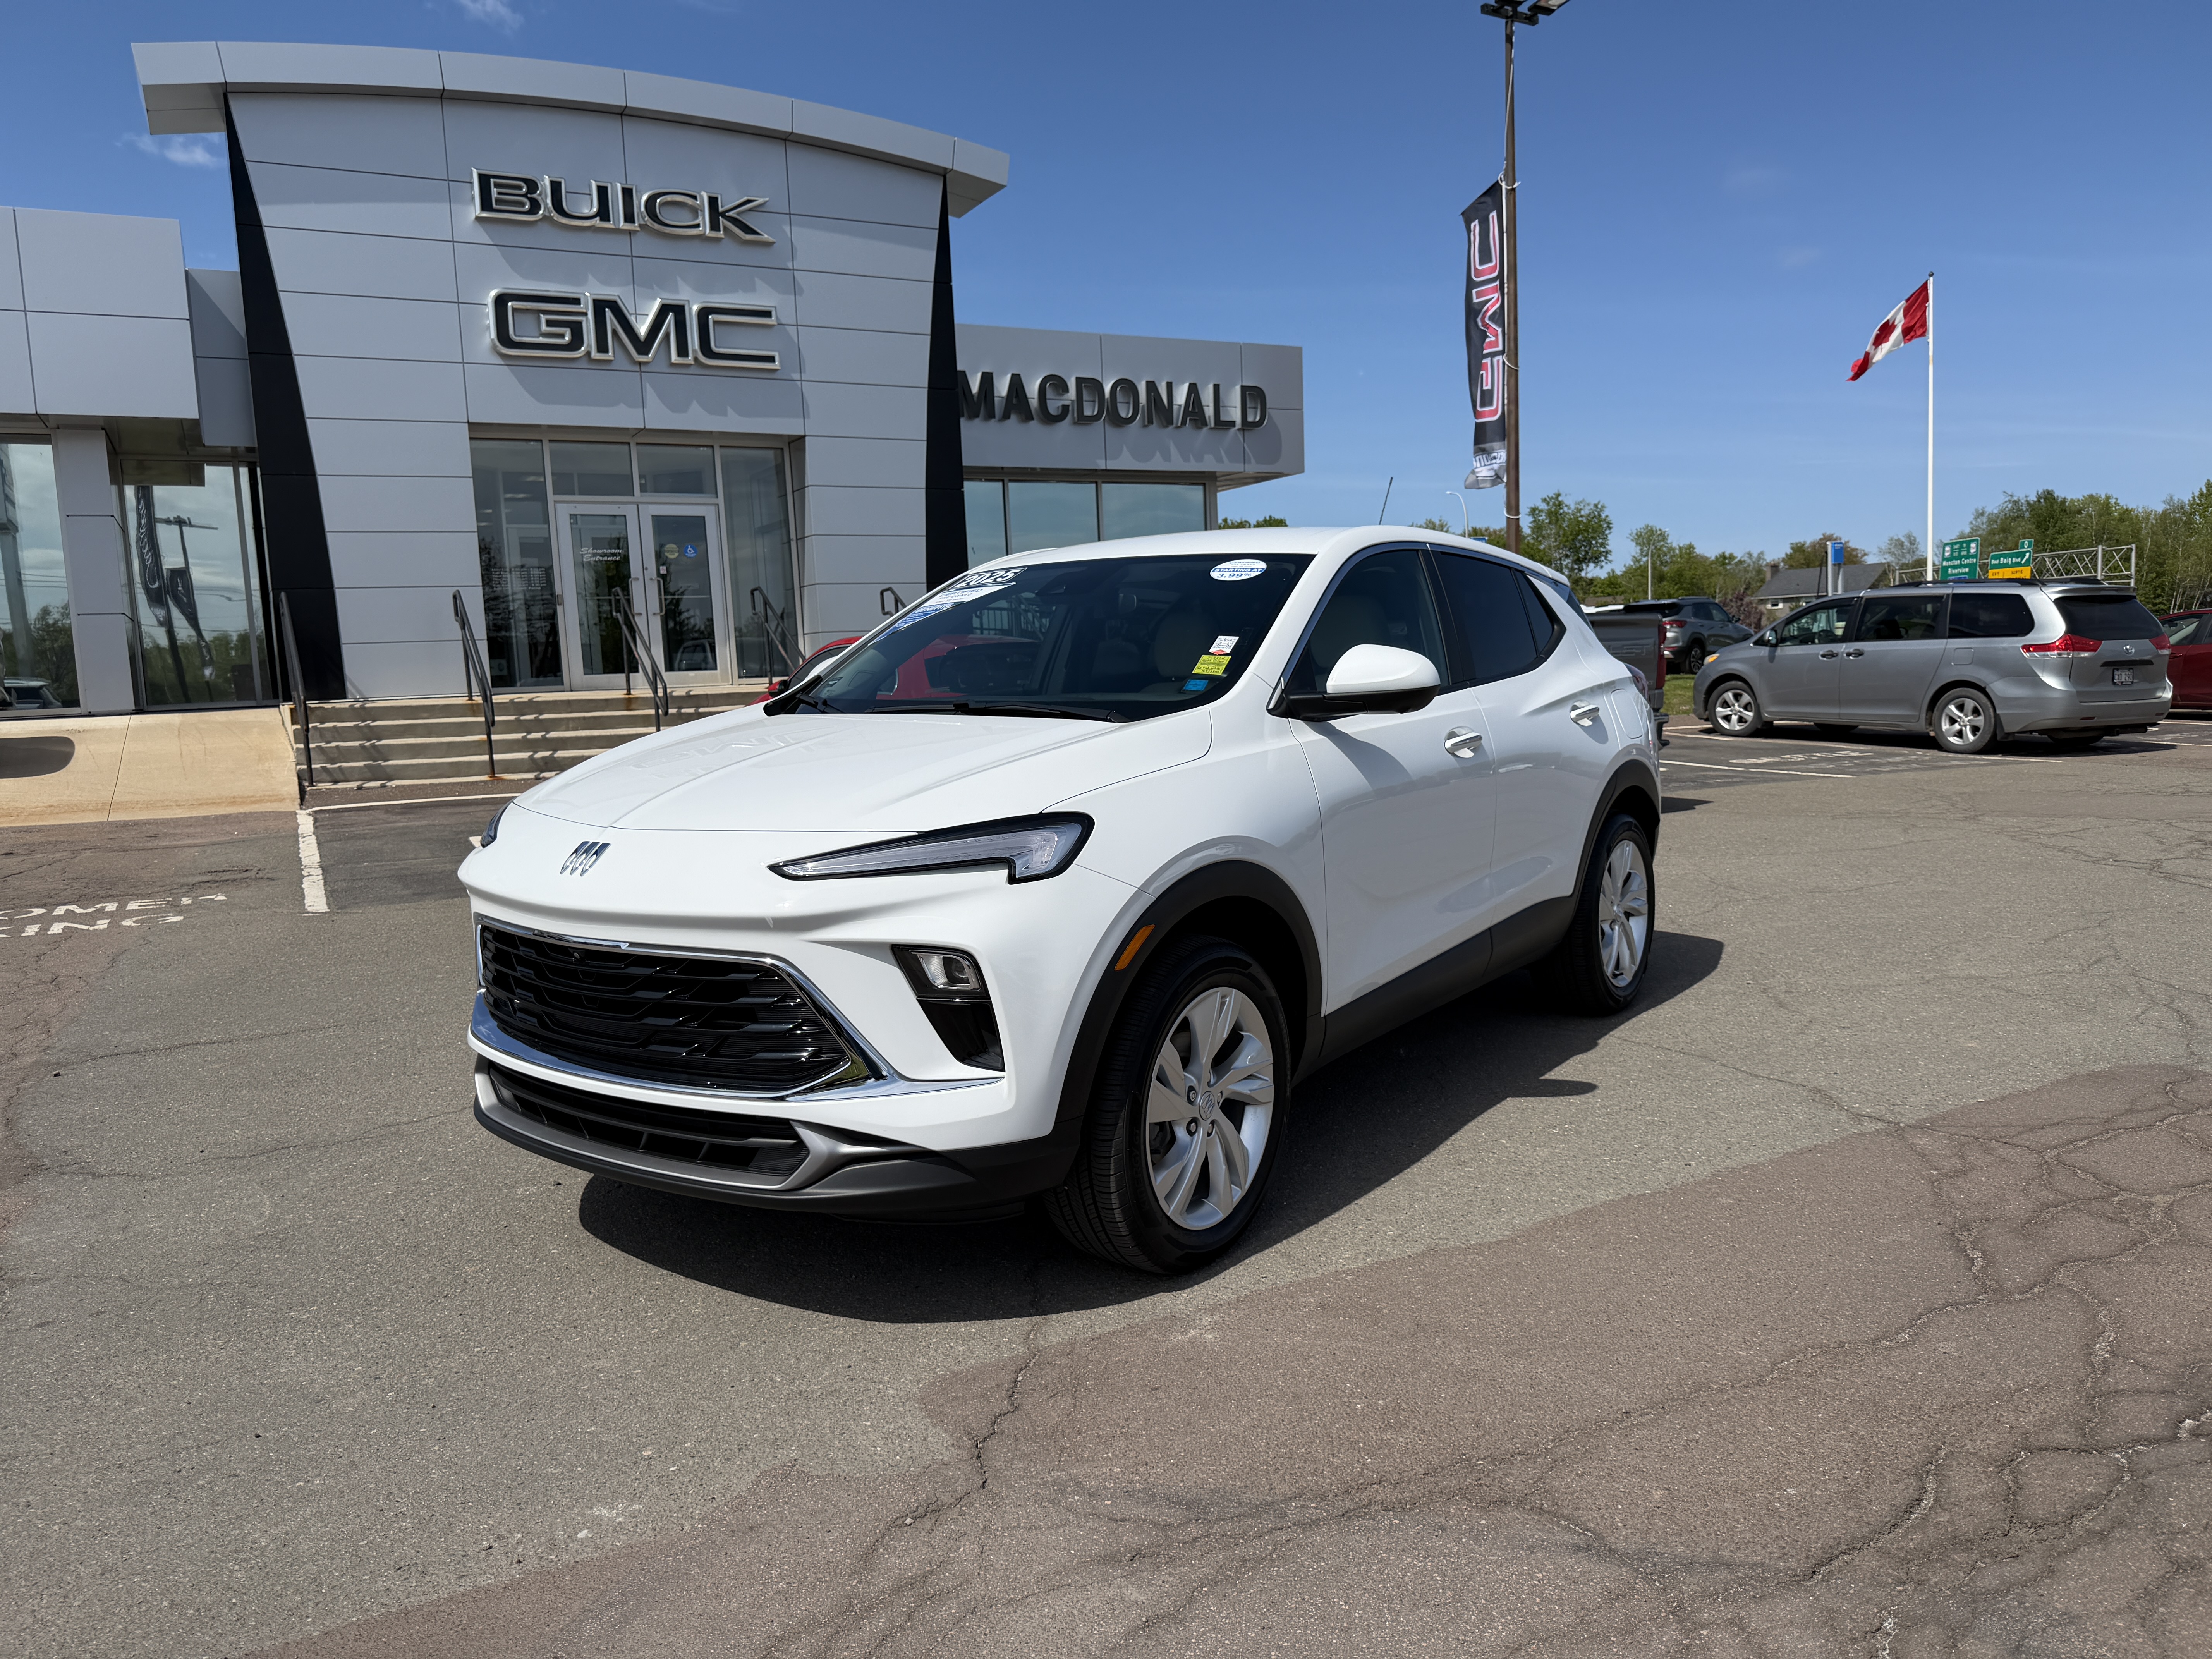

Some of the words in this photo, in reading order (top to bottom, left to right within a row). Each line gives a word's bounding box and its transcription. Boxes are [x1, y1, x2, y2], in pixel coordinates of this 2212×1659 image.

[472, 167, 776, 243] BUICK
[488, 287, 781, 369] GMC
[957, 370, 1268, 429] MACDONALD
[955, 569, 1022, 587] 2025
